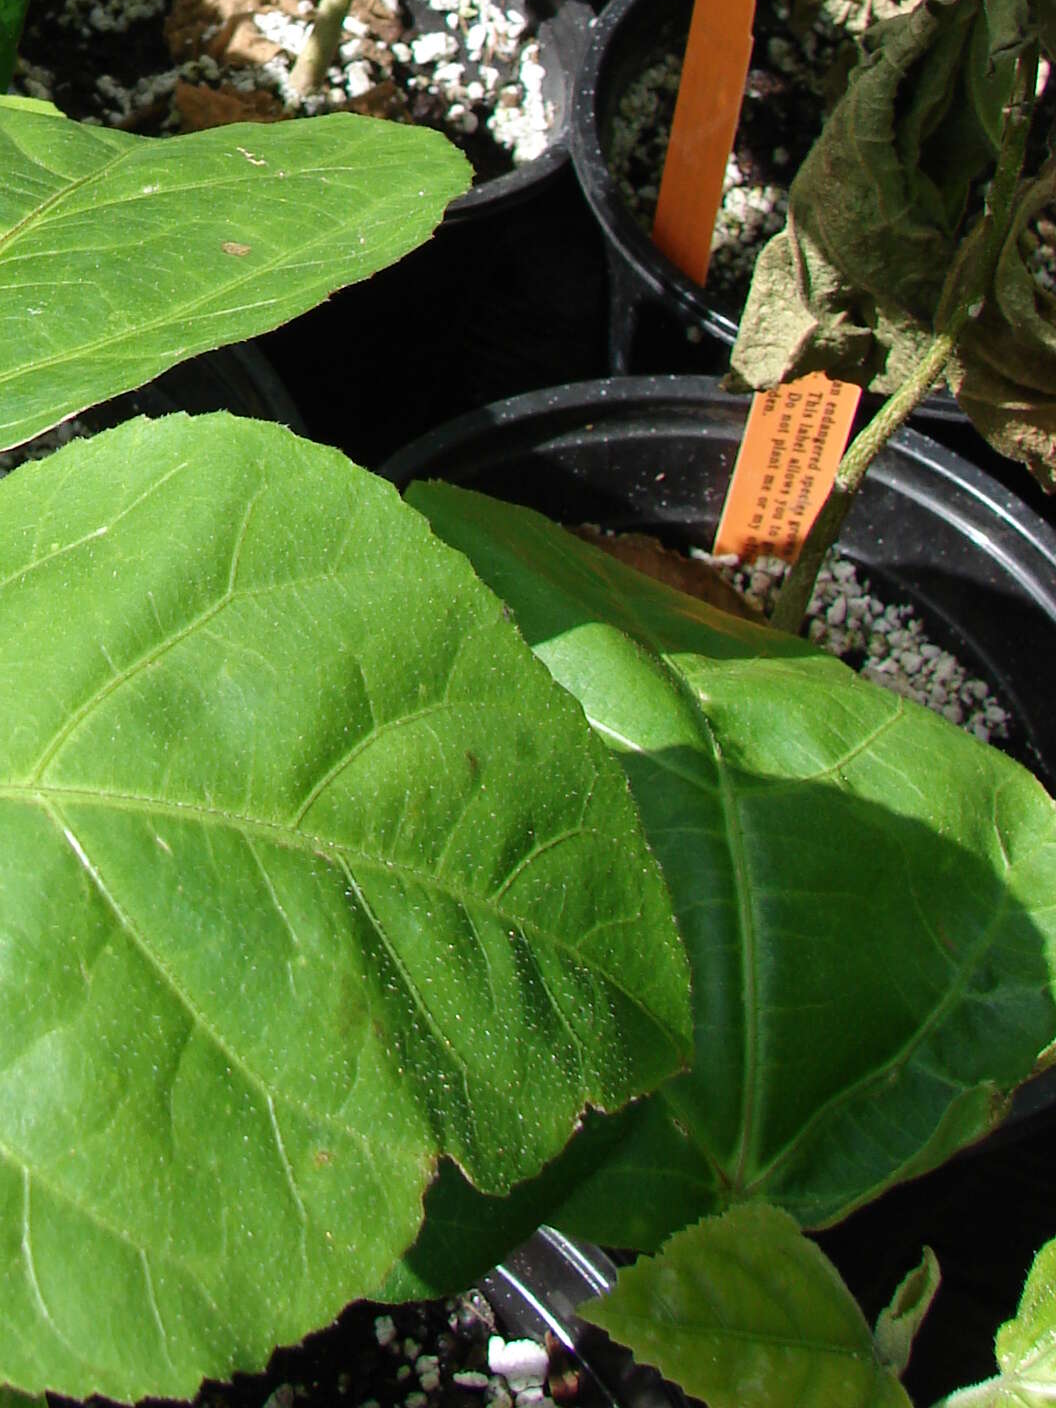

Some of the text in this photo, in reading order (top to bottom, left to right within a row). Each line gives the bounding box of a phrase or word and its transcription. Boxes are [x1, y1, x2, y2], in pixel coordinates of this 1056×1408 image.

[785, 391, 801, 410] Do
[802, 390, 822, 420] This
[778, 413, 794, 434] not
[792, 422, 810, 453] label
[806, 400, 837, 472] endangered
[766, 438, 786, 470] plant
[771, 498, 787, 520] you
[792, 474, 813, 517] species
[767, 524, 781, 538] to
